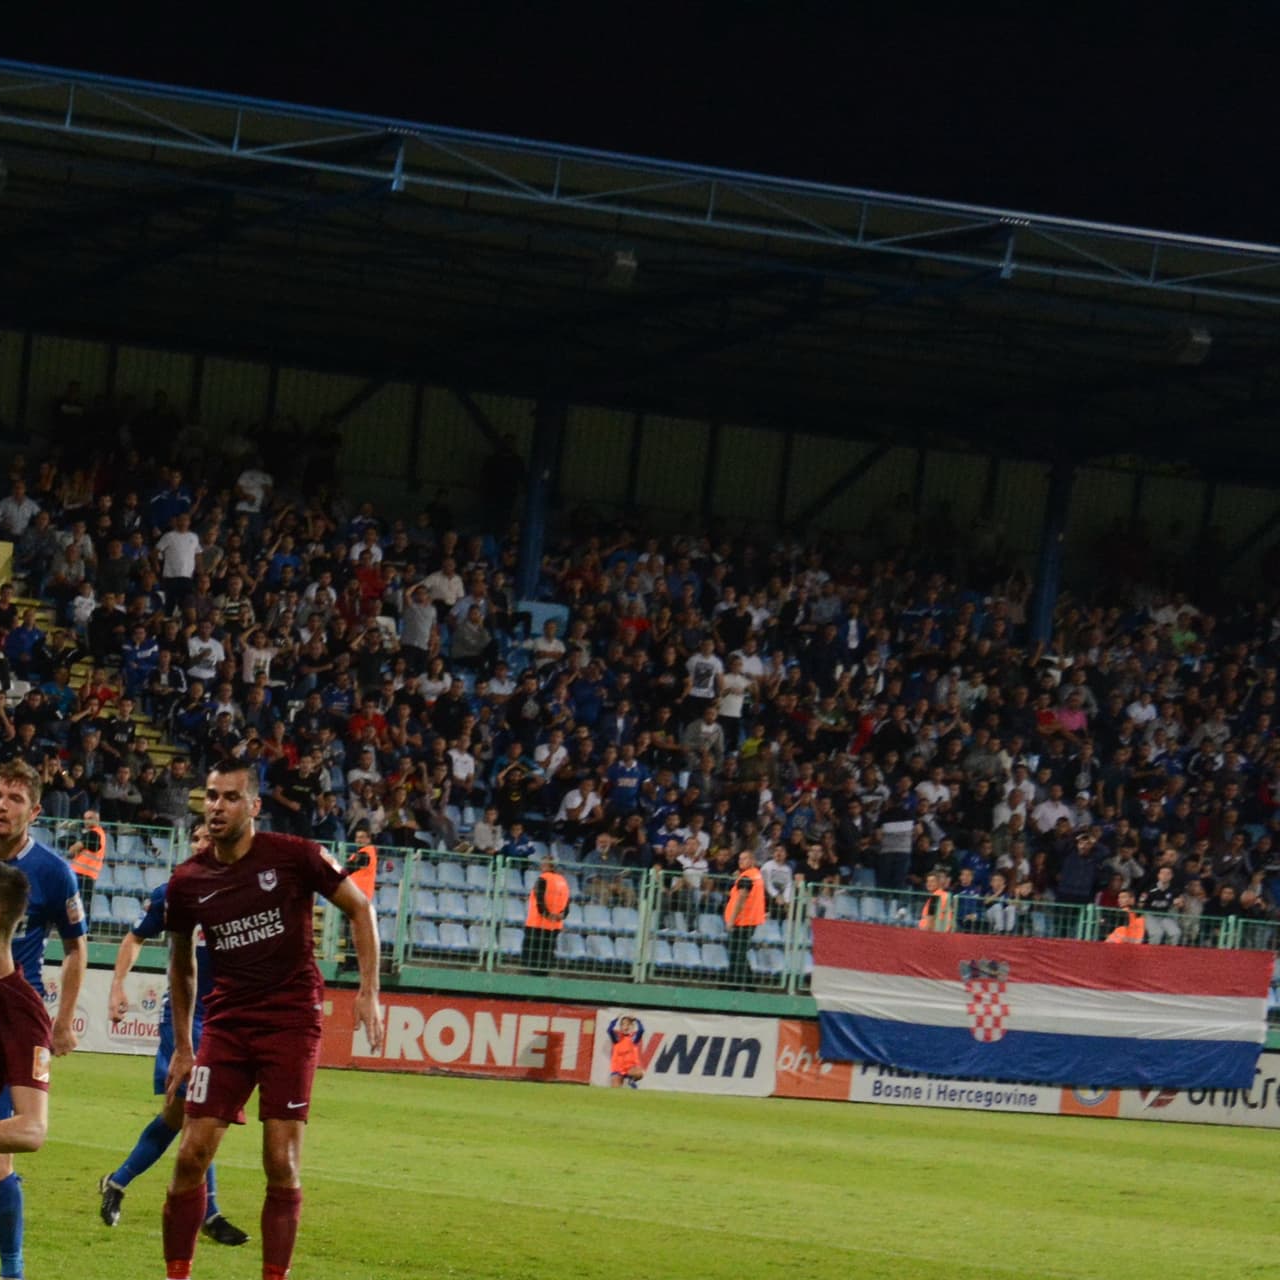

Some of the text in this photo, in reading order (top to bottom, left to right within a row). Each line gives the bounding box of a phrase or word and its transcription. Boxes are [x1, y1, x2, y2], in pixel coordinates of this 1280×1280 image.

[209, 907, 281, 937] TURKISH
[214, 920, 286, 951] AIRLINES
[872, 1079, 1038, 1107] Bosne i Hercegovine
